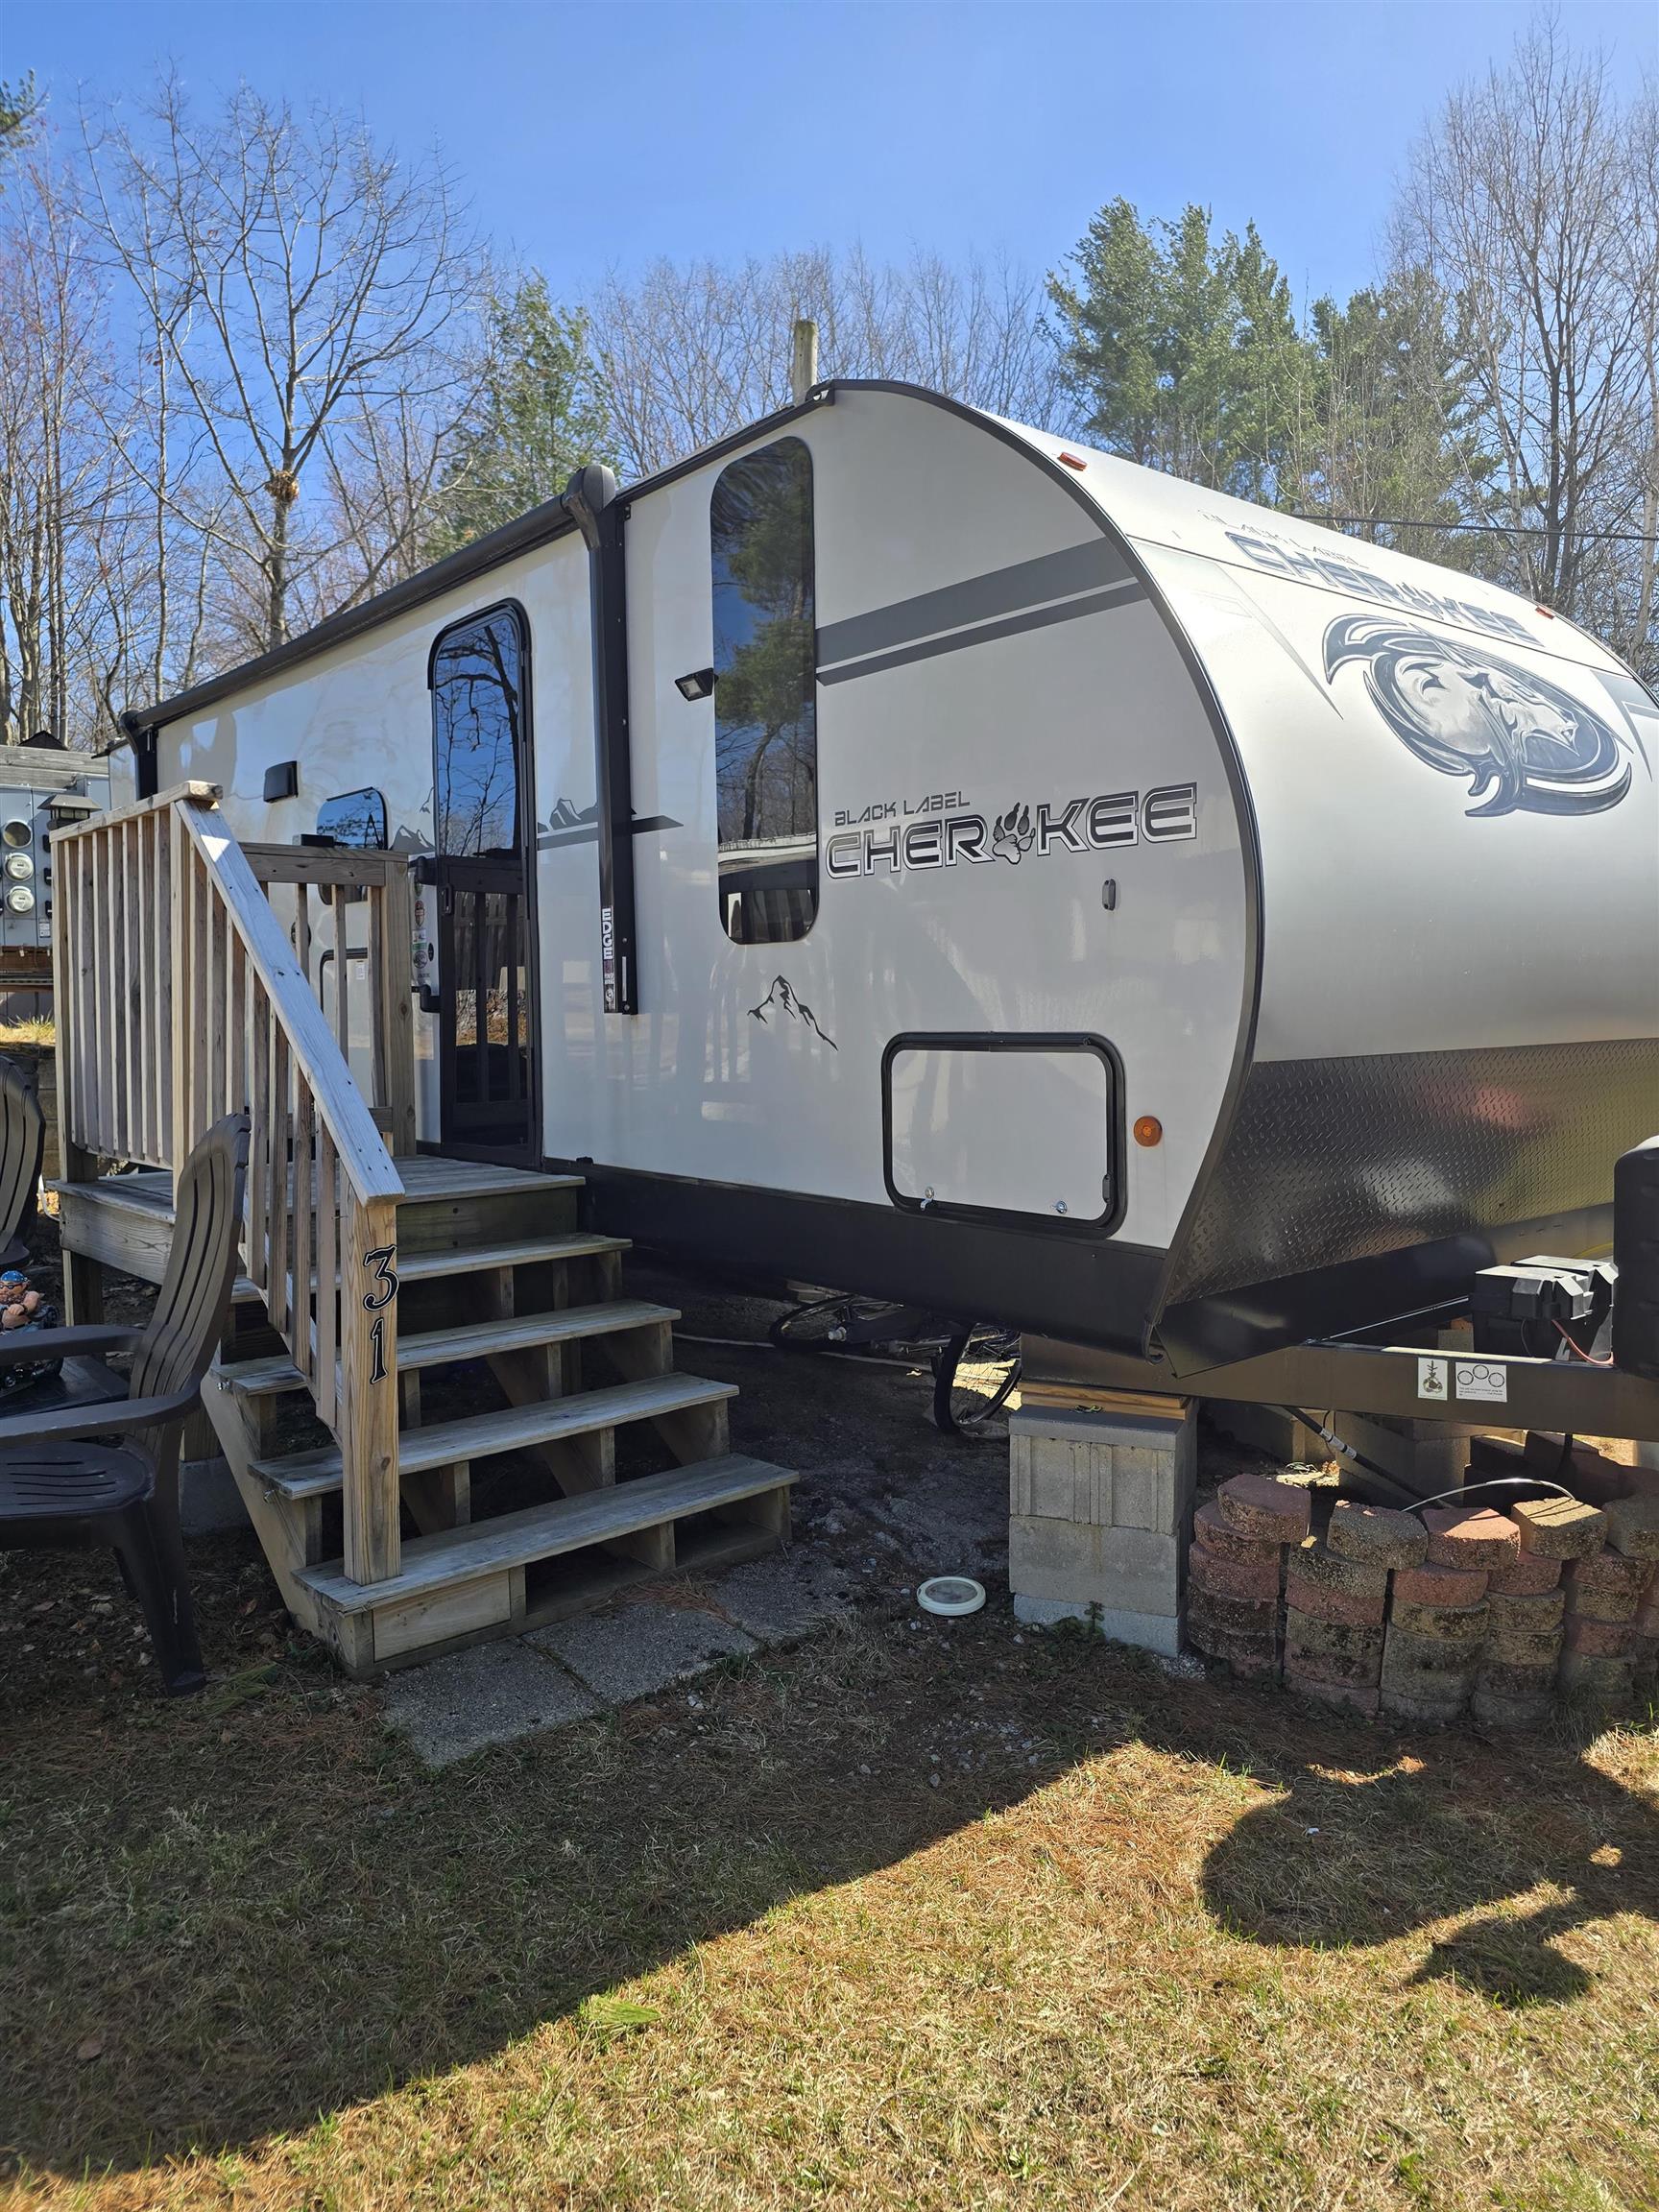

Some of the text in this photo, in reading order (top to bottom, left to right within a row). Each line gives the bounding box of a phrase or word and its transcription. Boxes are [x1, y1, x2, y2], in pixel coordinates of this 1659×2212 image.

[834, 791, 971, 827] BLACK LABEL
[601, 907, 613, 960] EDGE
[363, 1243, 399, 1384] 31
